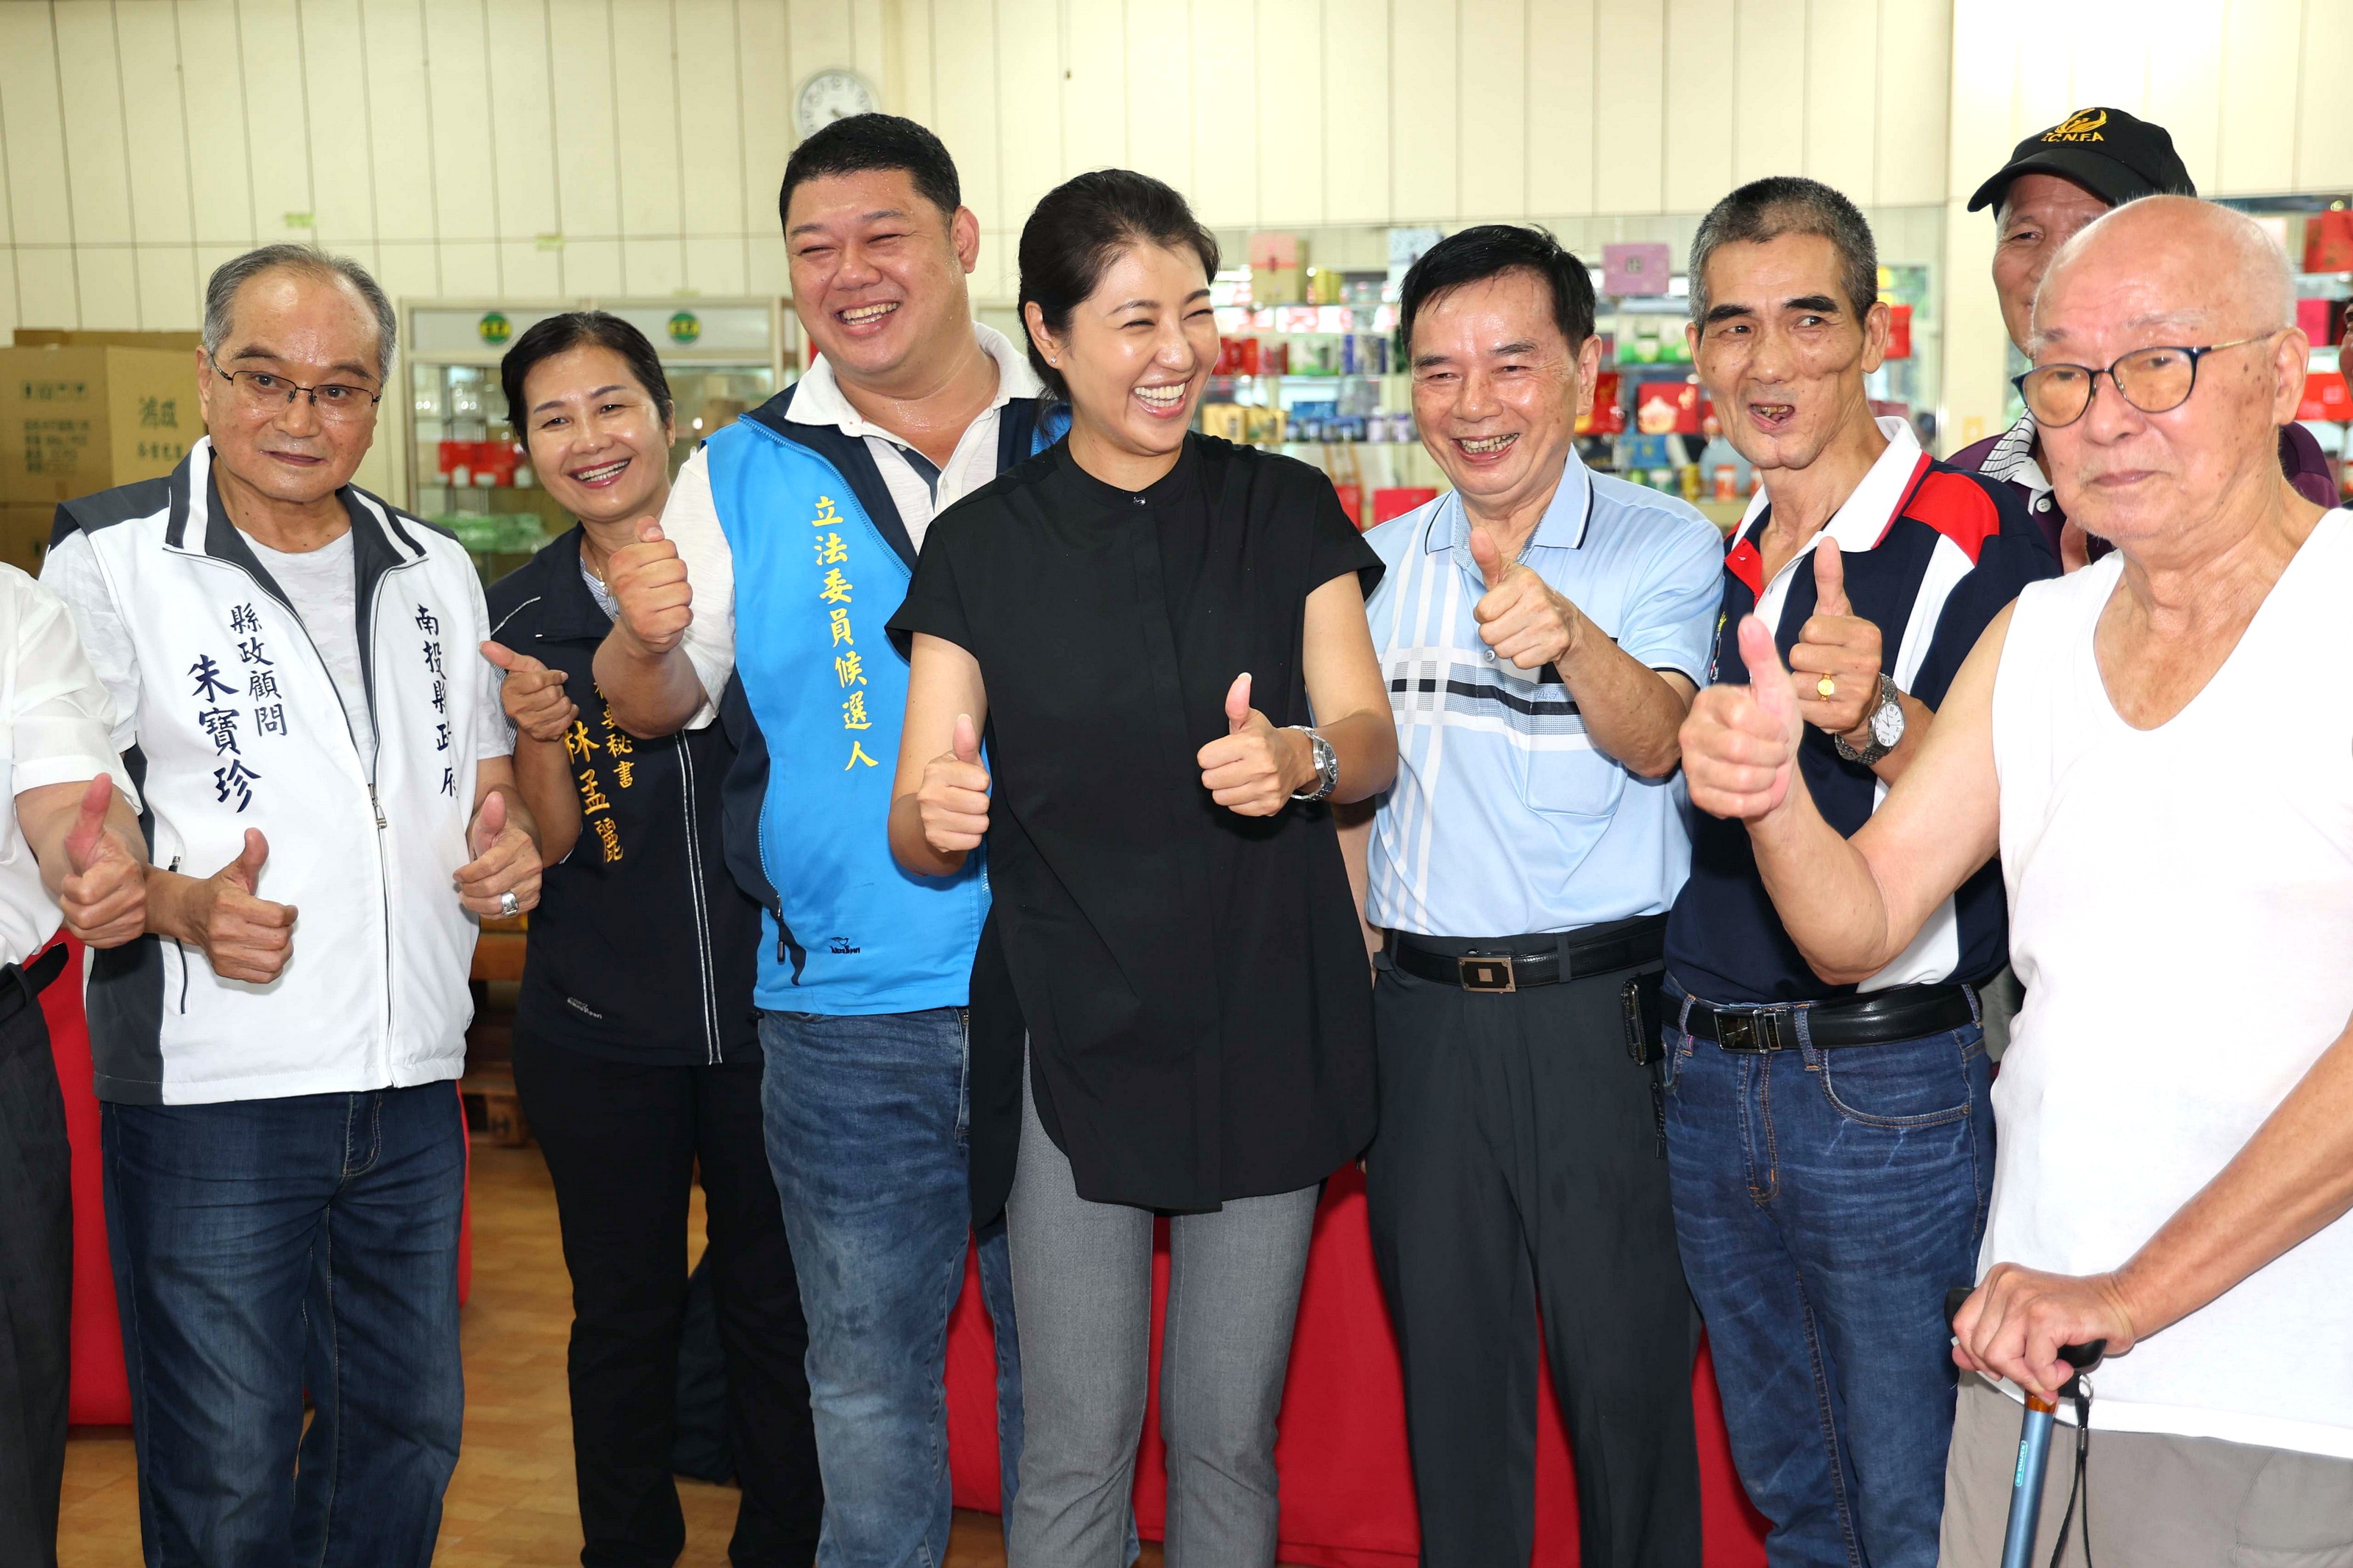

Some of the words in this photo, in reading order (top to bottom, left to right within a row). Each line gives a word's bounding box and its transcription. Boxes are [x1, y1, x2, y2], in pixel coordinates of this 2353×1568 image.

[229, 602, 288, 737] 縣政顧問
[811, 495, 879, 772] 立法委員候選人
[187, 654, 263, 813] 朱寶珍
[563, 720, 625, 863] 林孟麗
